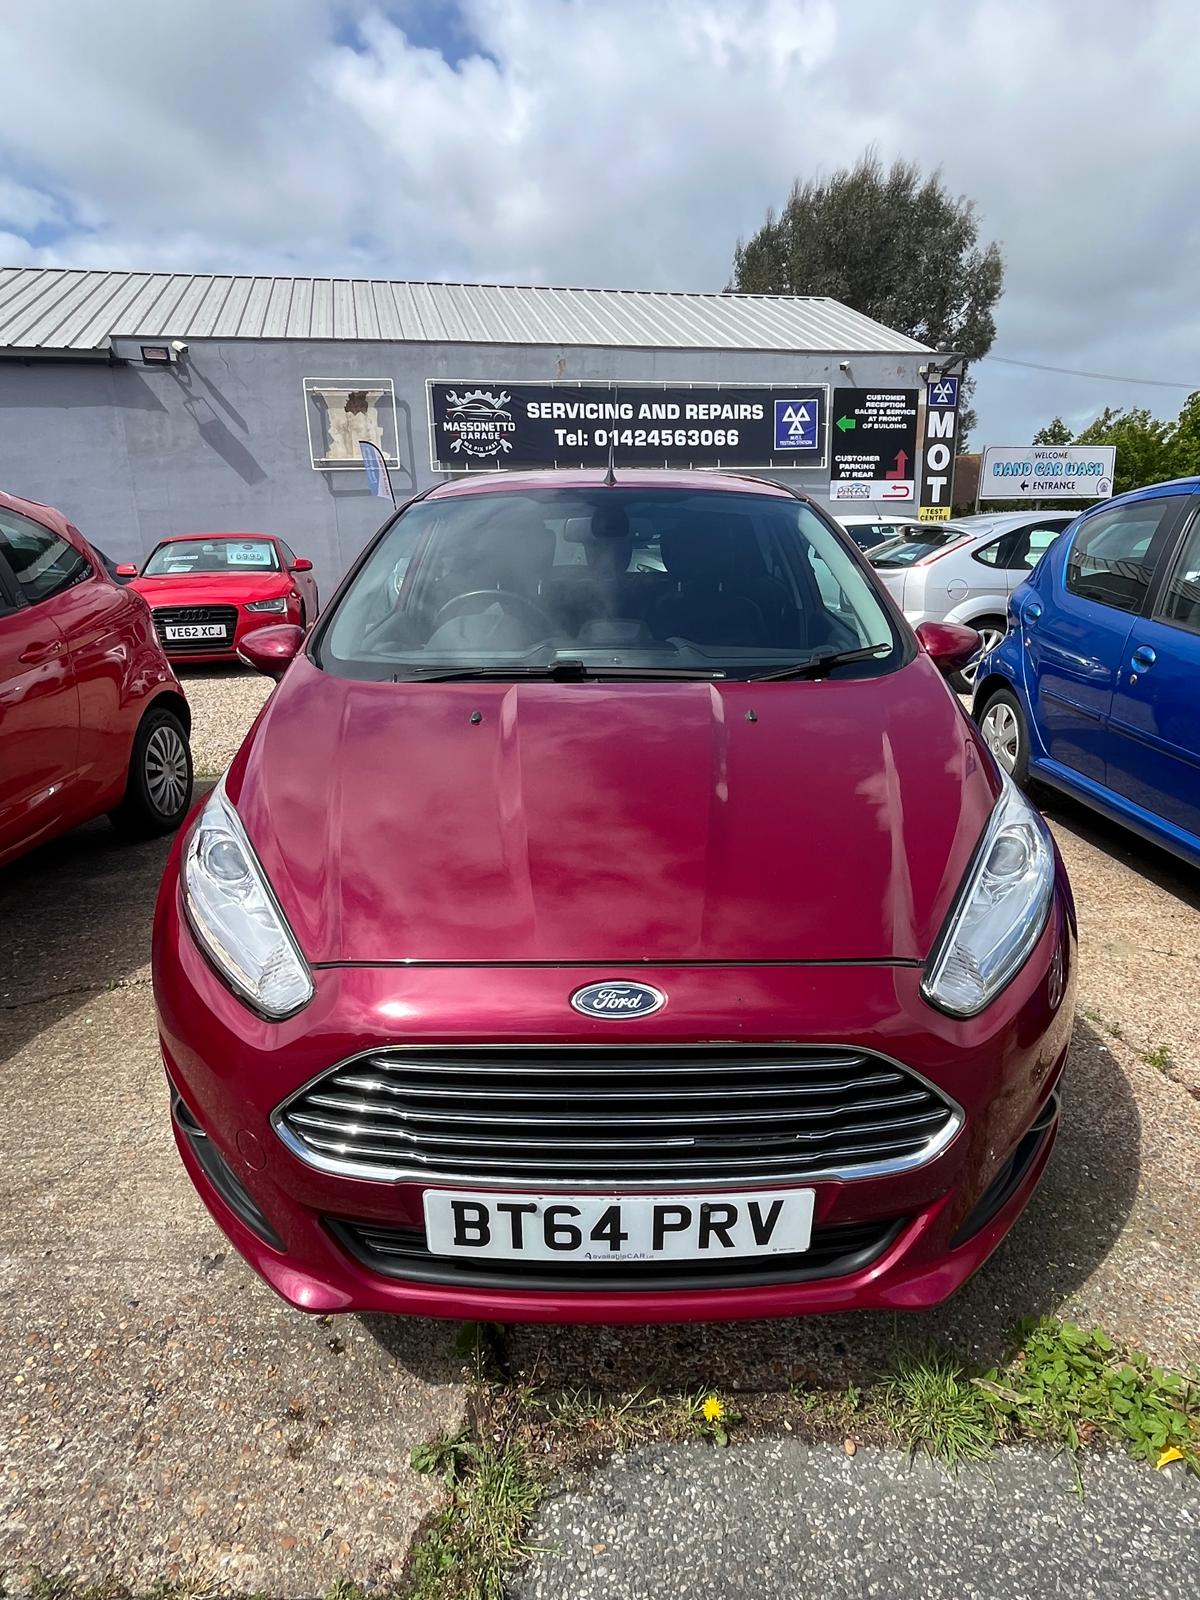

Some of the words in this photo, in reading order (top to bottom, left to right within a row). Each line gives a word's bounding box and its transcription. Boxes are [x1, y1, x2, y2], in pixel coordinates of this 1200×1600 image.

[526, 402, 634, 419] SERVICING
[638, 403, 681, 420] AND
[685, 403, 764, 420] REPAIRS
[443, 422, 516, 431] MASSONETTO
[460, 432, 500, 440] GARAGE
[554, 429, 588, 446] Tel:
[594, 429, 739, 446] 01424563066
[926, 411, 955, 503] MOT
[1034, 451, 1068, 459] WELCOME
[992, 462, 1033, 477] HAND
[1034, 462, 1064, 477] CAR
[1065, 462, 1105, 477] WASH
[1032, 481, 1076, 490] ENTRANCE
[170, 627, 199, 638] VE62
[200, 626, 223, 637] XCJ
[592, 989, 643, 1009] Ford
[450, 1200, 629, 1252] BT64
[652, 1199, 785, 1251] PRV
